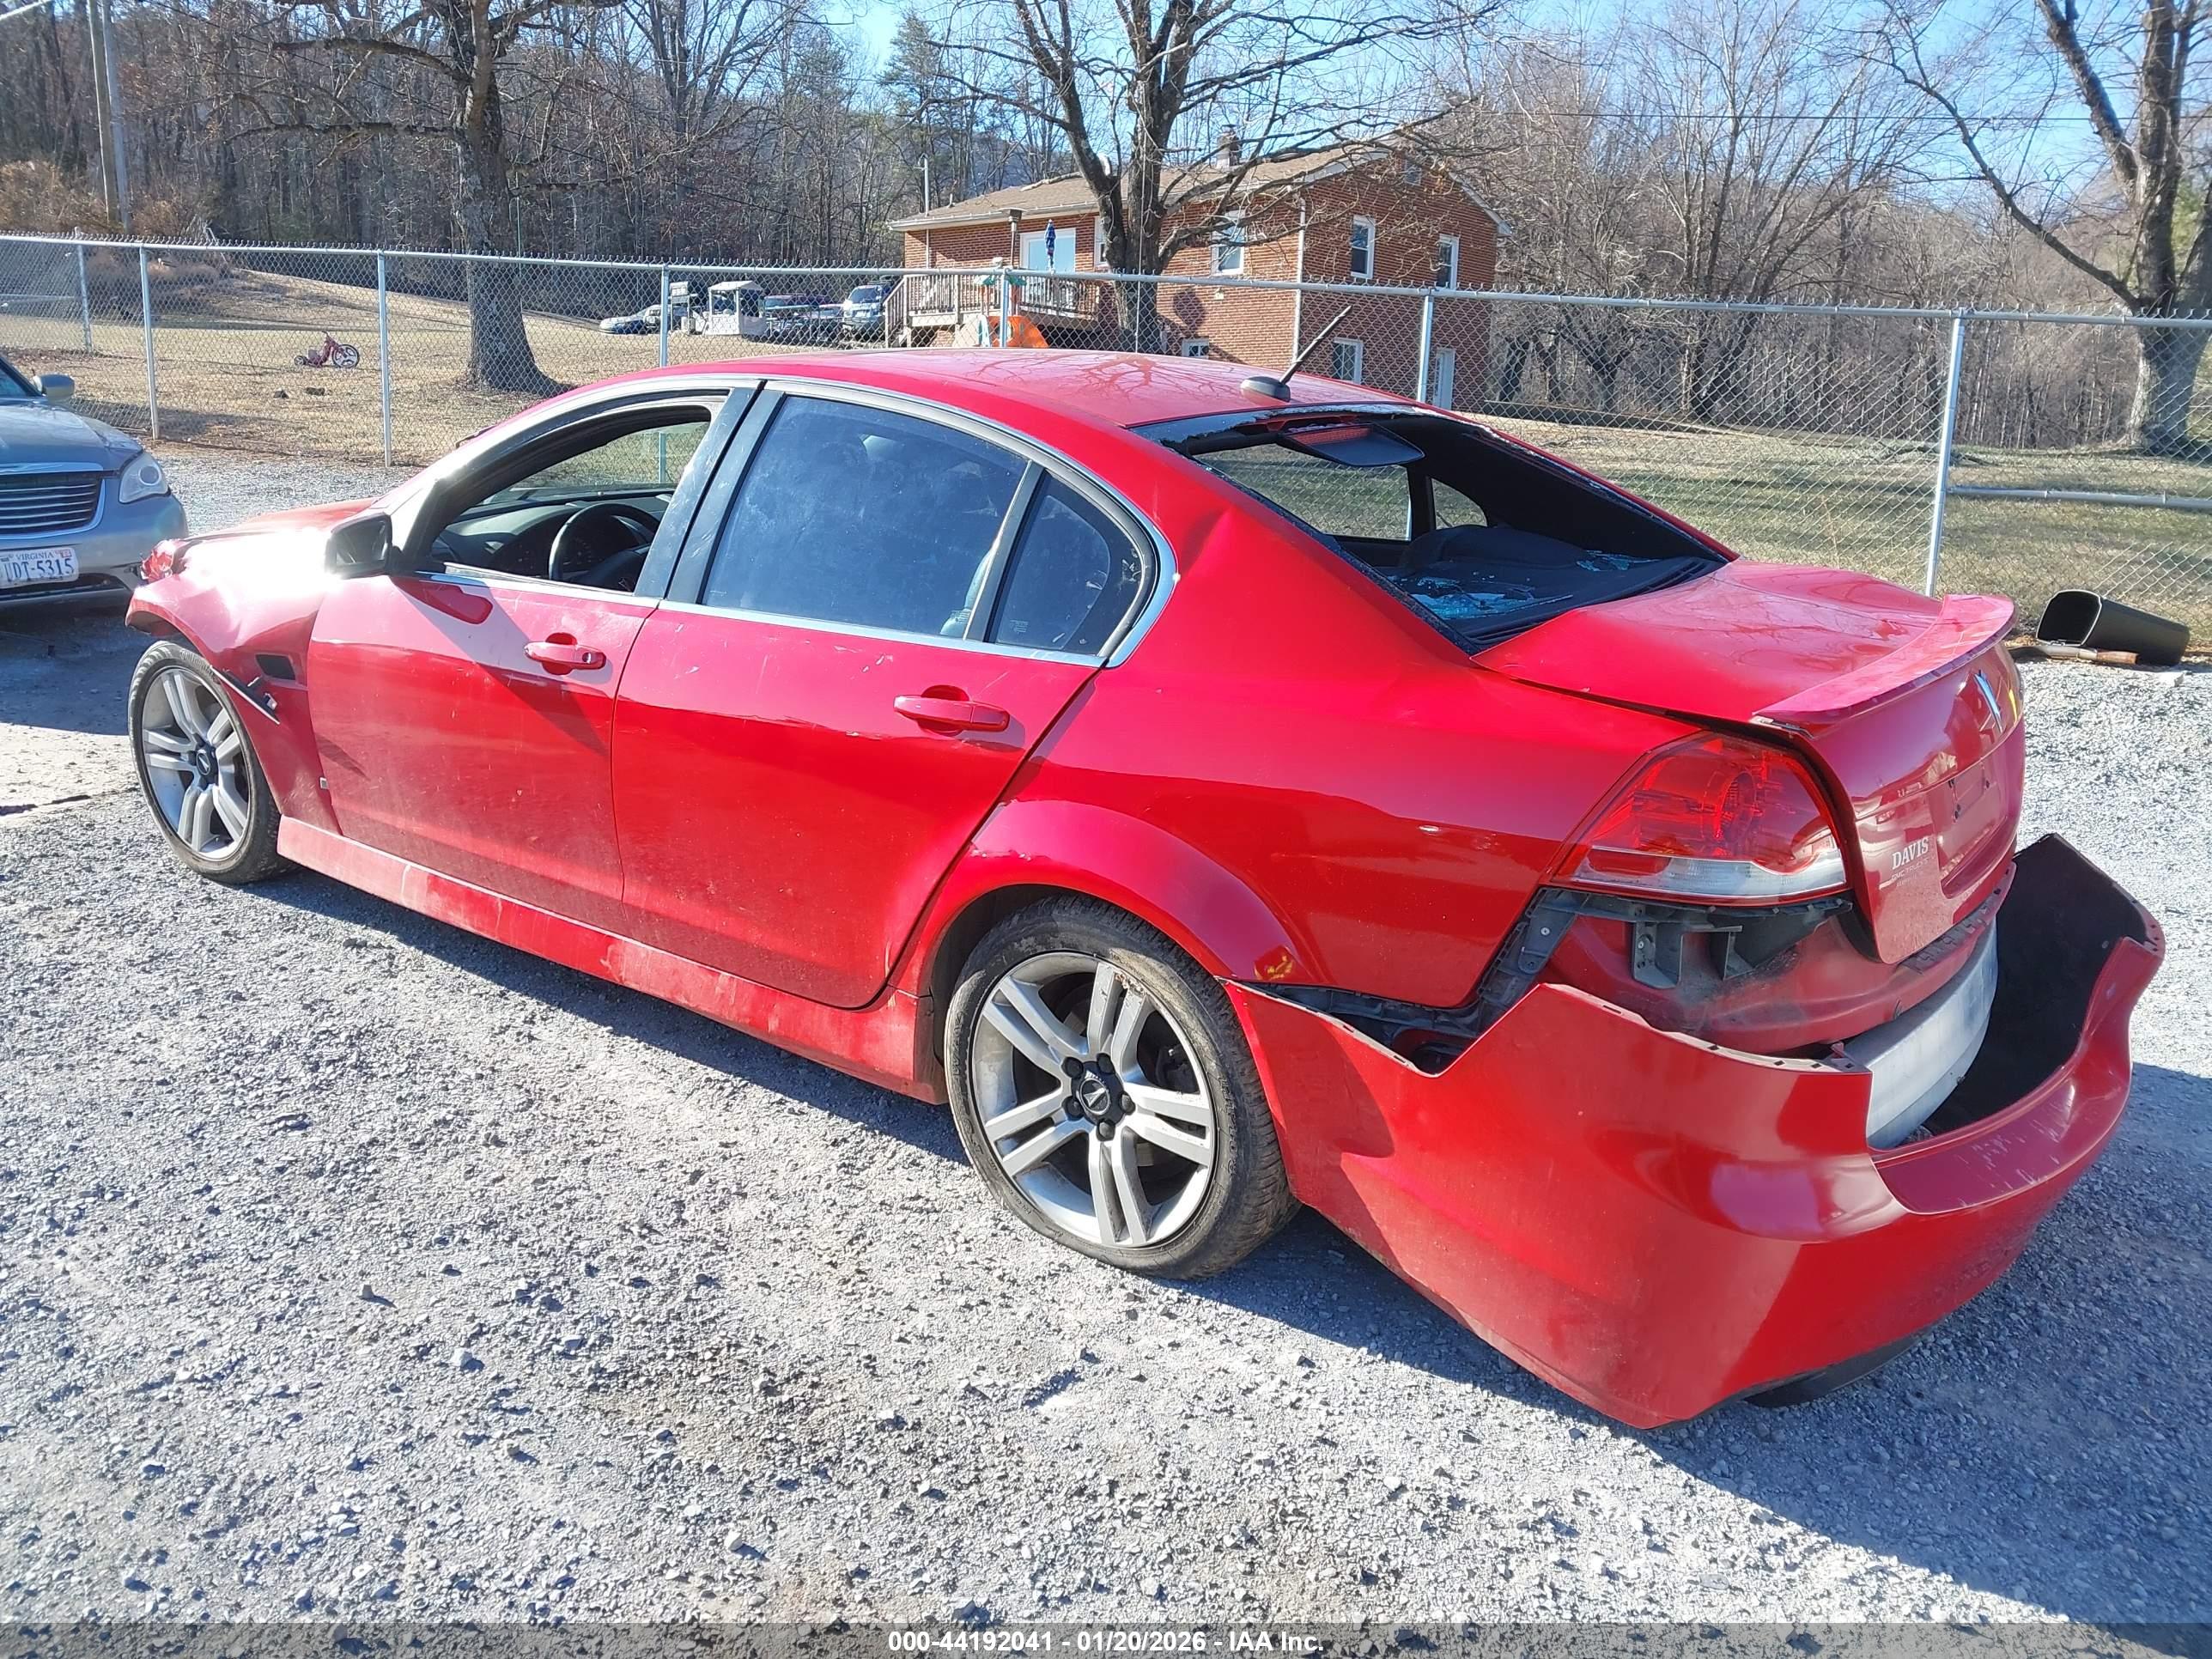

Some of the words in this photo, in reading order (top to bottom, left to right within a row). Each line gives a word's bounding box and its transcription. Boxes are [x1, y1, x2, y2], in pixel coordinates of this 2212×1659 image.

[15, 551, 55, 561] VIRGINIA
[3, 557, 75, 582] UDT-5315
[1892, 836, 1929, 870] DAVIS
